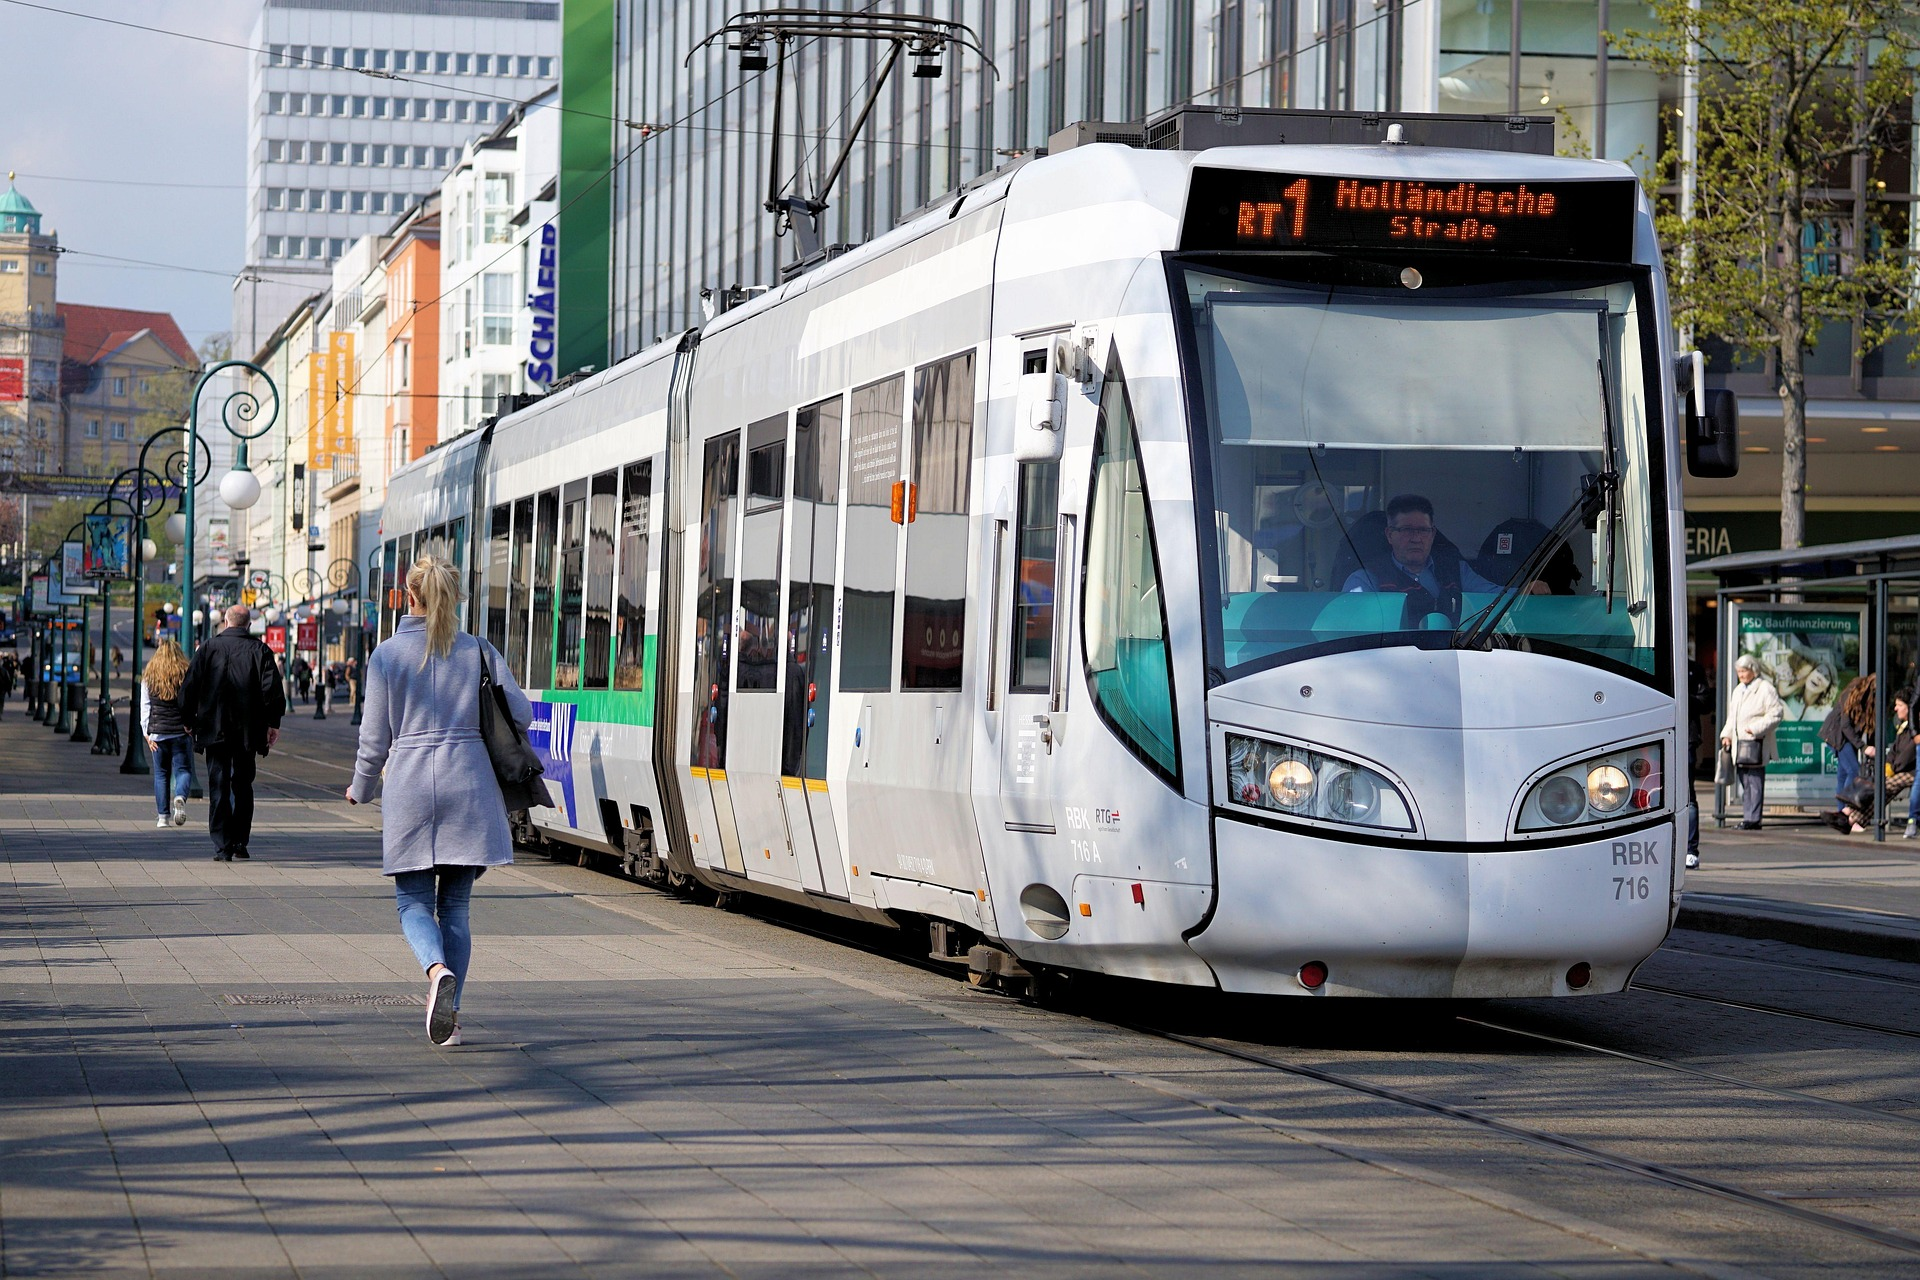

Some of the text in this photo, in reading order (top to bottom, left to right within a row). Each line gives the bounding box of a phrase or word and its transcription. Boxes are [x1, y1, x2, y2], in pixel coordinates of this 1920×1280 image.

[1336, 180, 1555, 215] Holländische
[1390, 216, 1497, 240] Straße
[1742, 617, 1852, 632] PSD Baufinanzierung
[1065, 806, 1091, 830] RBK
[1095, 808, 1111, 824] RTG
[1071, 839, 1102, 863] 716 A
[1611, 841, 1659, 865] RBK
[1612, 876, 1649, 900] 716
